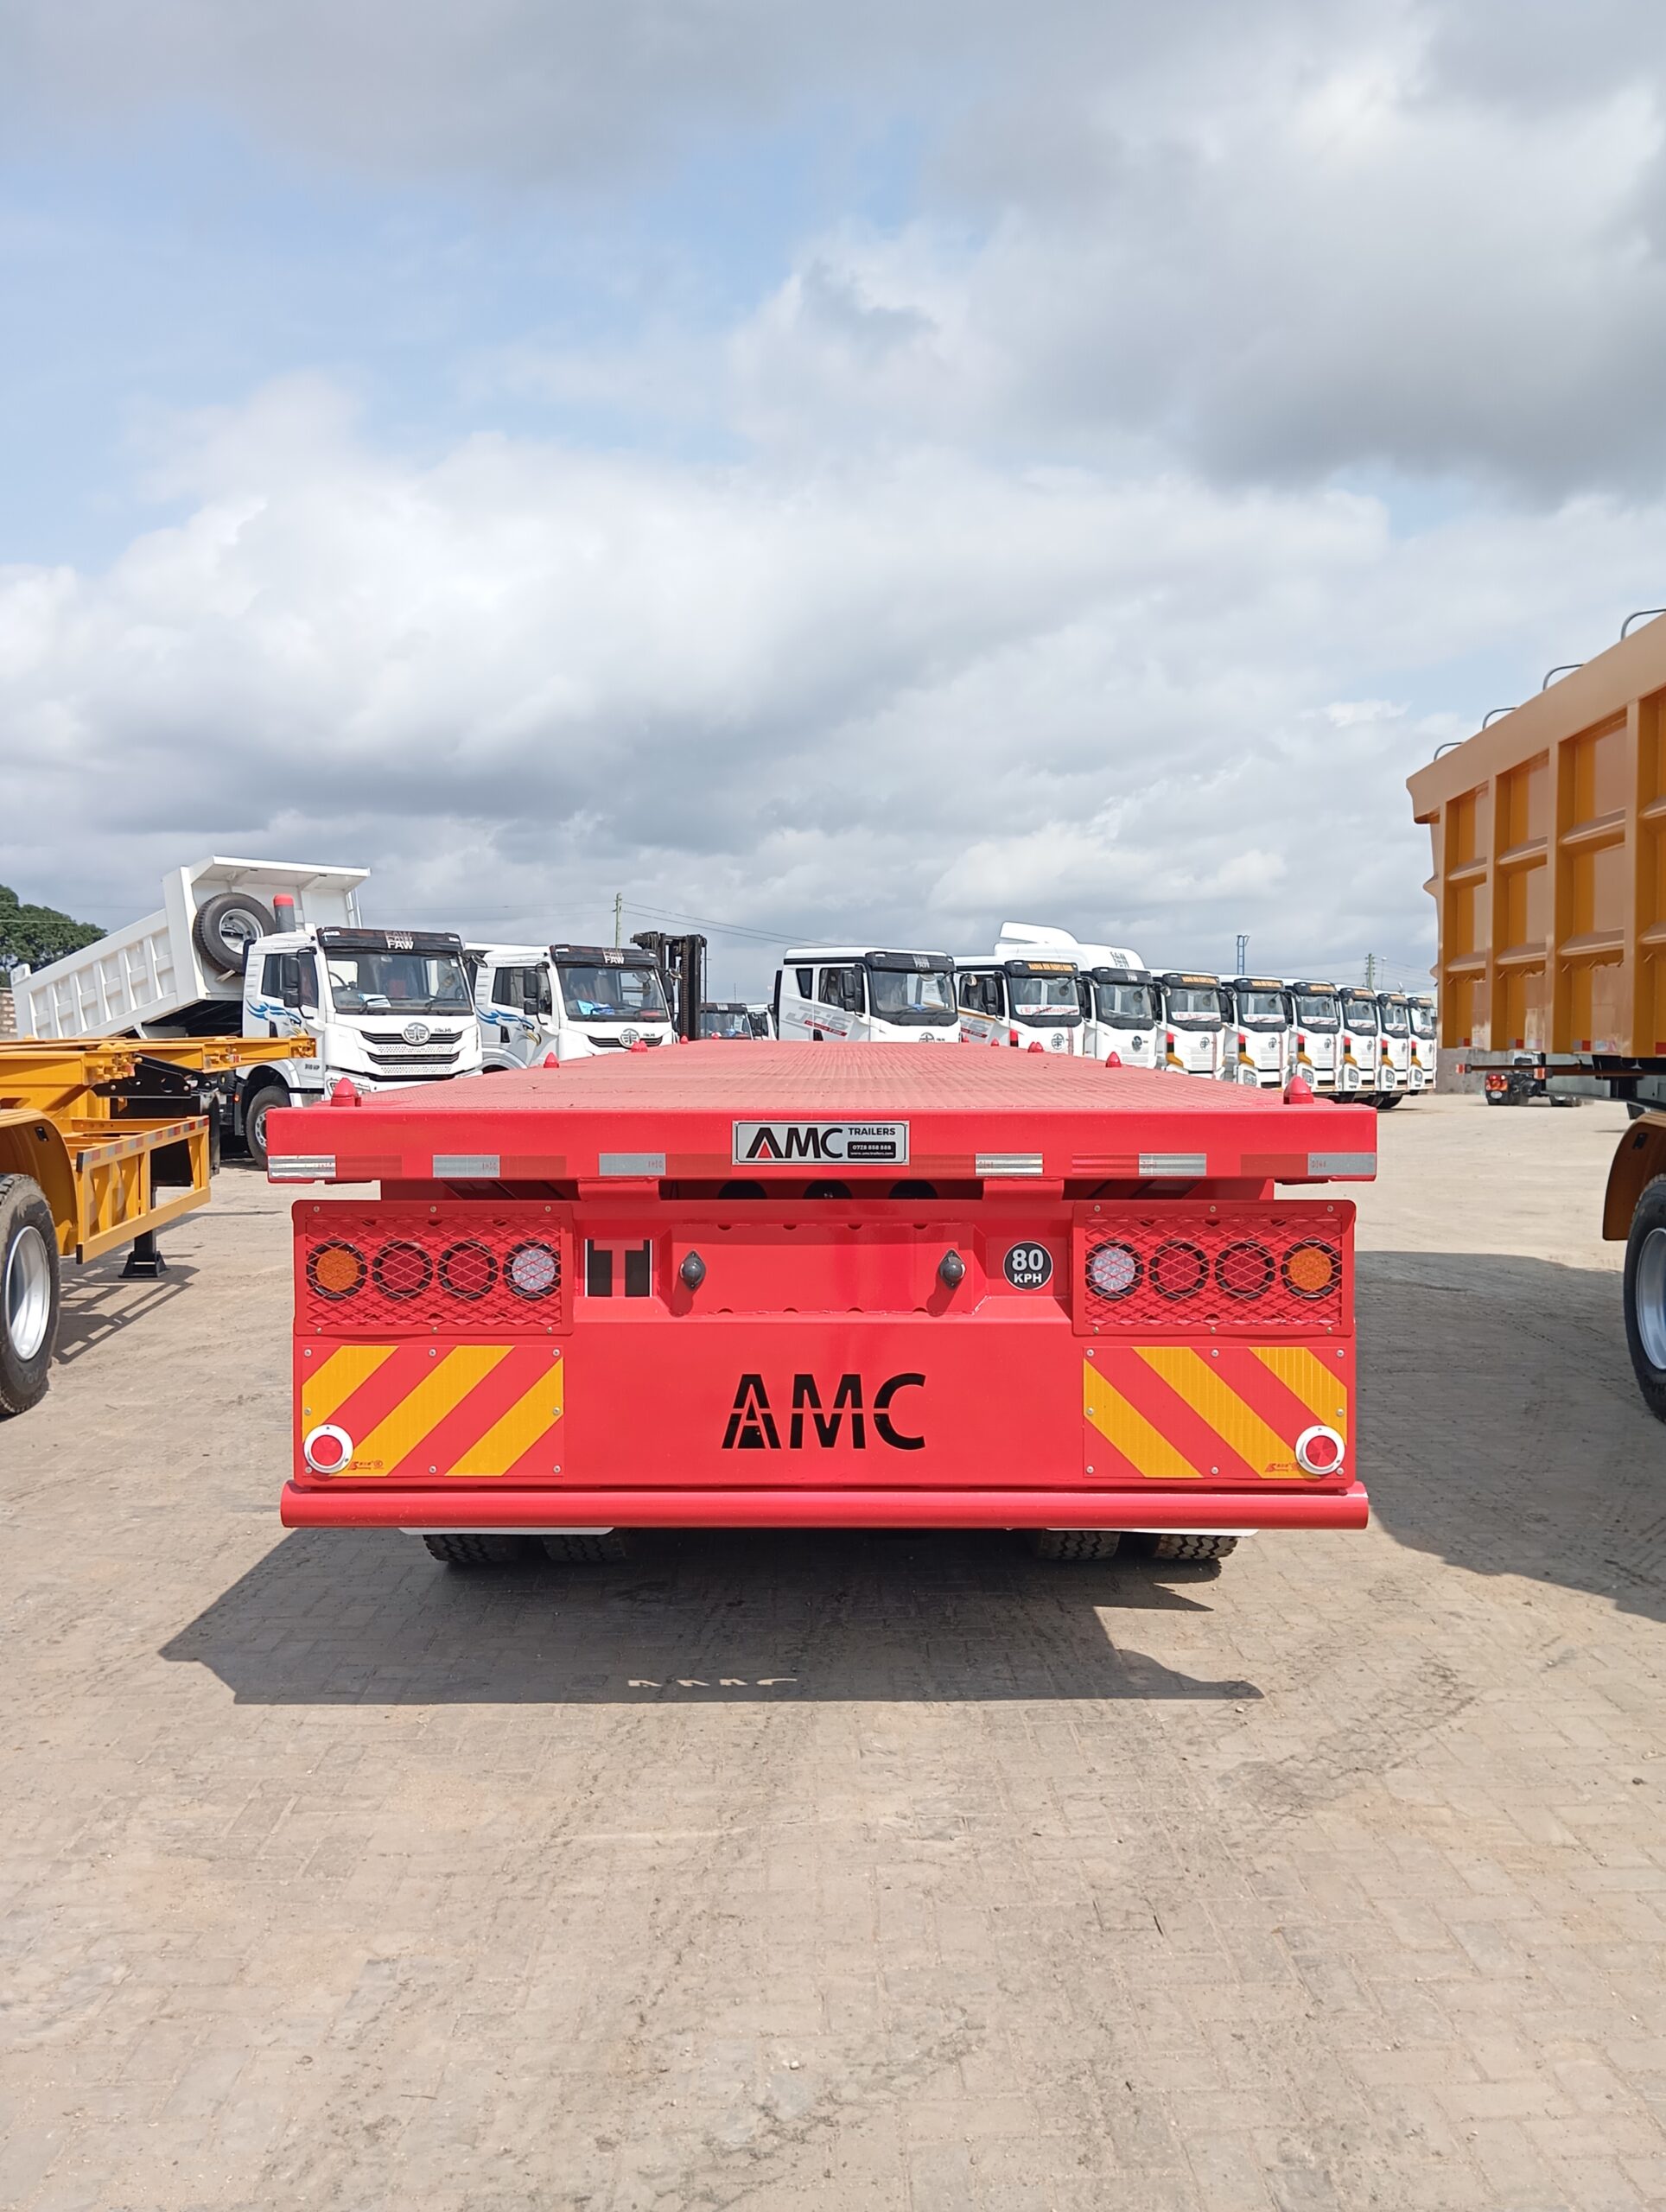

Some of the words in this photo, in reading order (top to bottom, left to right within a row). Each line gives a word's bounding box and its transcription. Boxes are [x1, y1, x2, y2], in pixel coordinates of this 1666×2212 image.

[386, 941, 415, 950] FAW
[746, 1127, 843, 1159] AMC
[1012, 1249, 1044, 1271] 80
[1014, 1273, 1042, 1283] KPH
[722, 1373, 926, 1451] AMC
